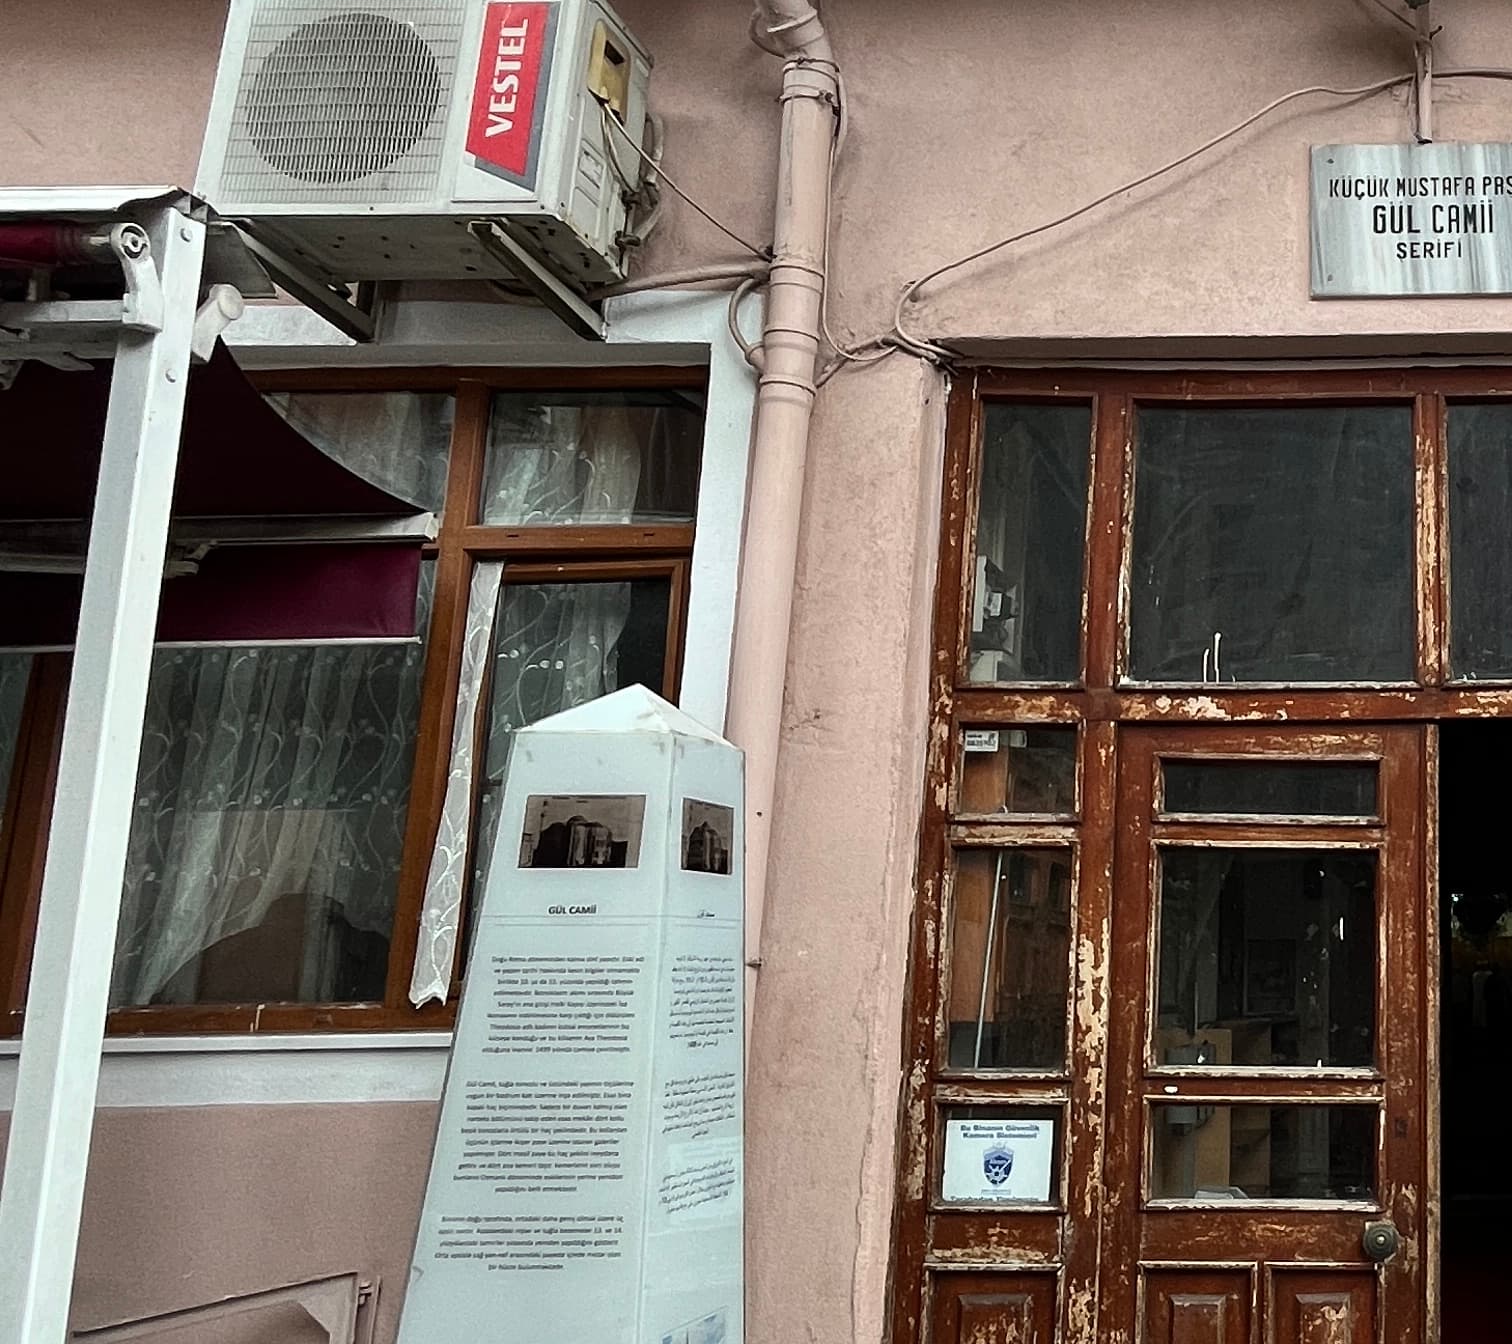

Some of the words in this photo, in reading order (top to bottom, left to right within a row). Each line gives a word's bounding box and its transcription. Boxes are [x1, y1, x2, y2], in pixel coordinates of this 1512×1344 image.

[485, 19, 529, 137] VESTEL
[1329, 174, 1389, 200] KÜÇÜK
[1396, 176, 1475, 197] MUSTAFA
[1373, 201, 1420, 234] GÜL
[1432, 199, 1493, 234] CAMİİ
[1397, 238, 1462, 262] ŞERİFİ
[548, 905, 566, 914] GÜL
[569, 904, 596, 914] CAMİİ
